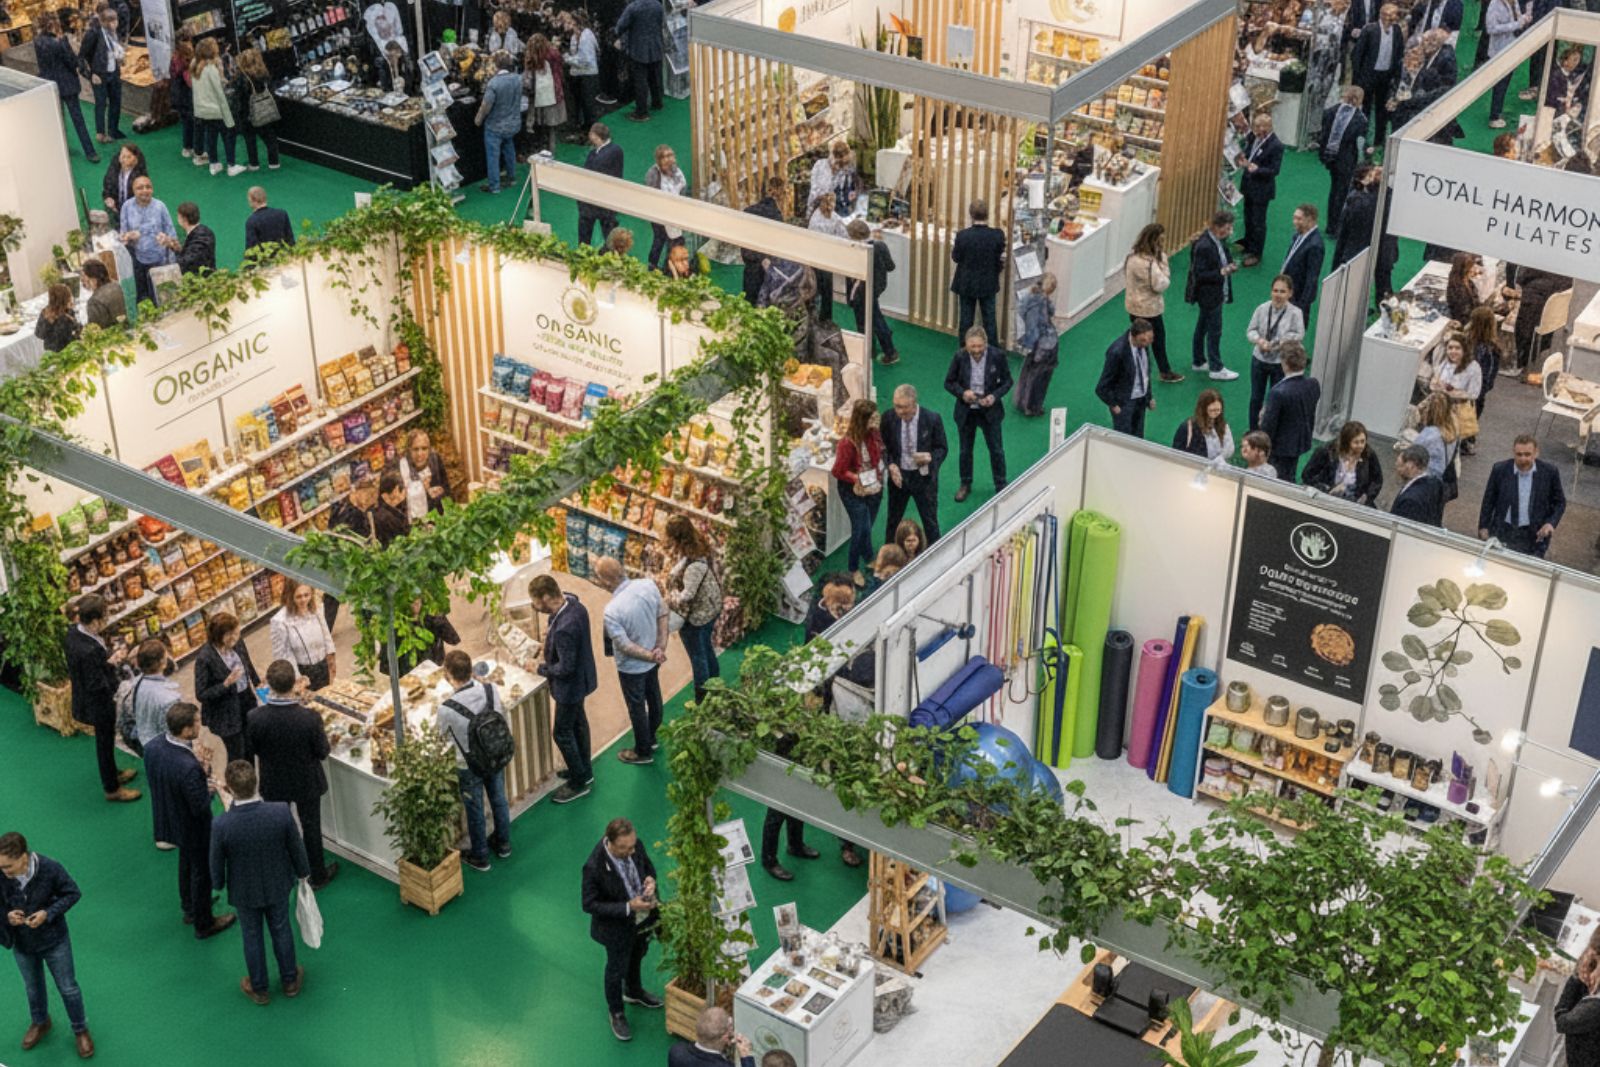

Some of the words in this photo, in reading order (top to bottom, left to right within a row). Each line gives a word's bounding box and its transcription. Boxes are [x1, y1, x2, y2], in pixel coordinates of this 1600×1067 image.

[1412, 171, 1484, 207] TOTAL
[1486, 216, 1592, 255] PILATES
[153, 331, 270, 406] ORGANIC
